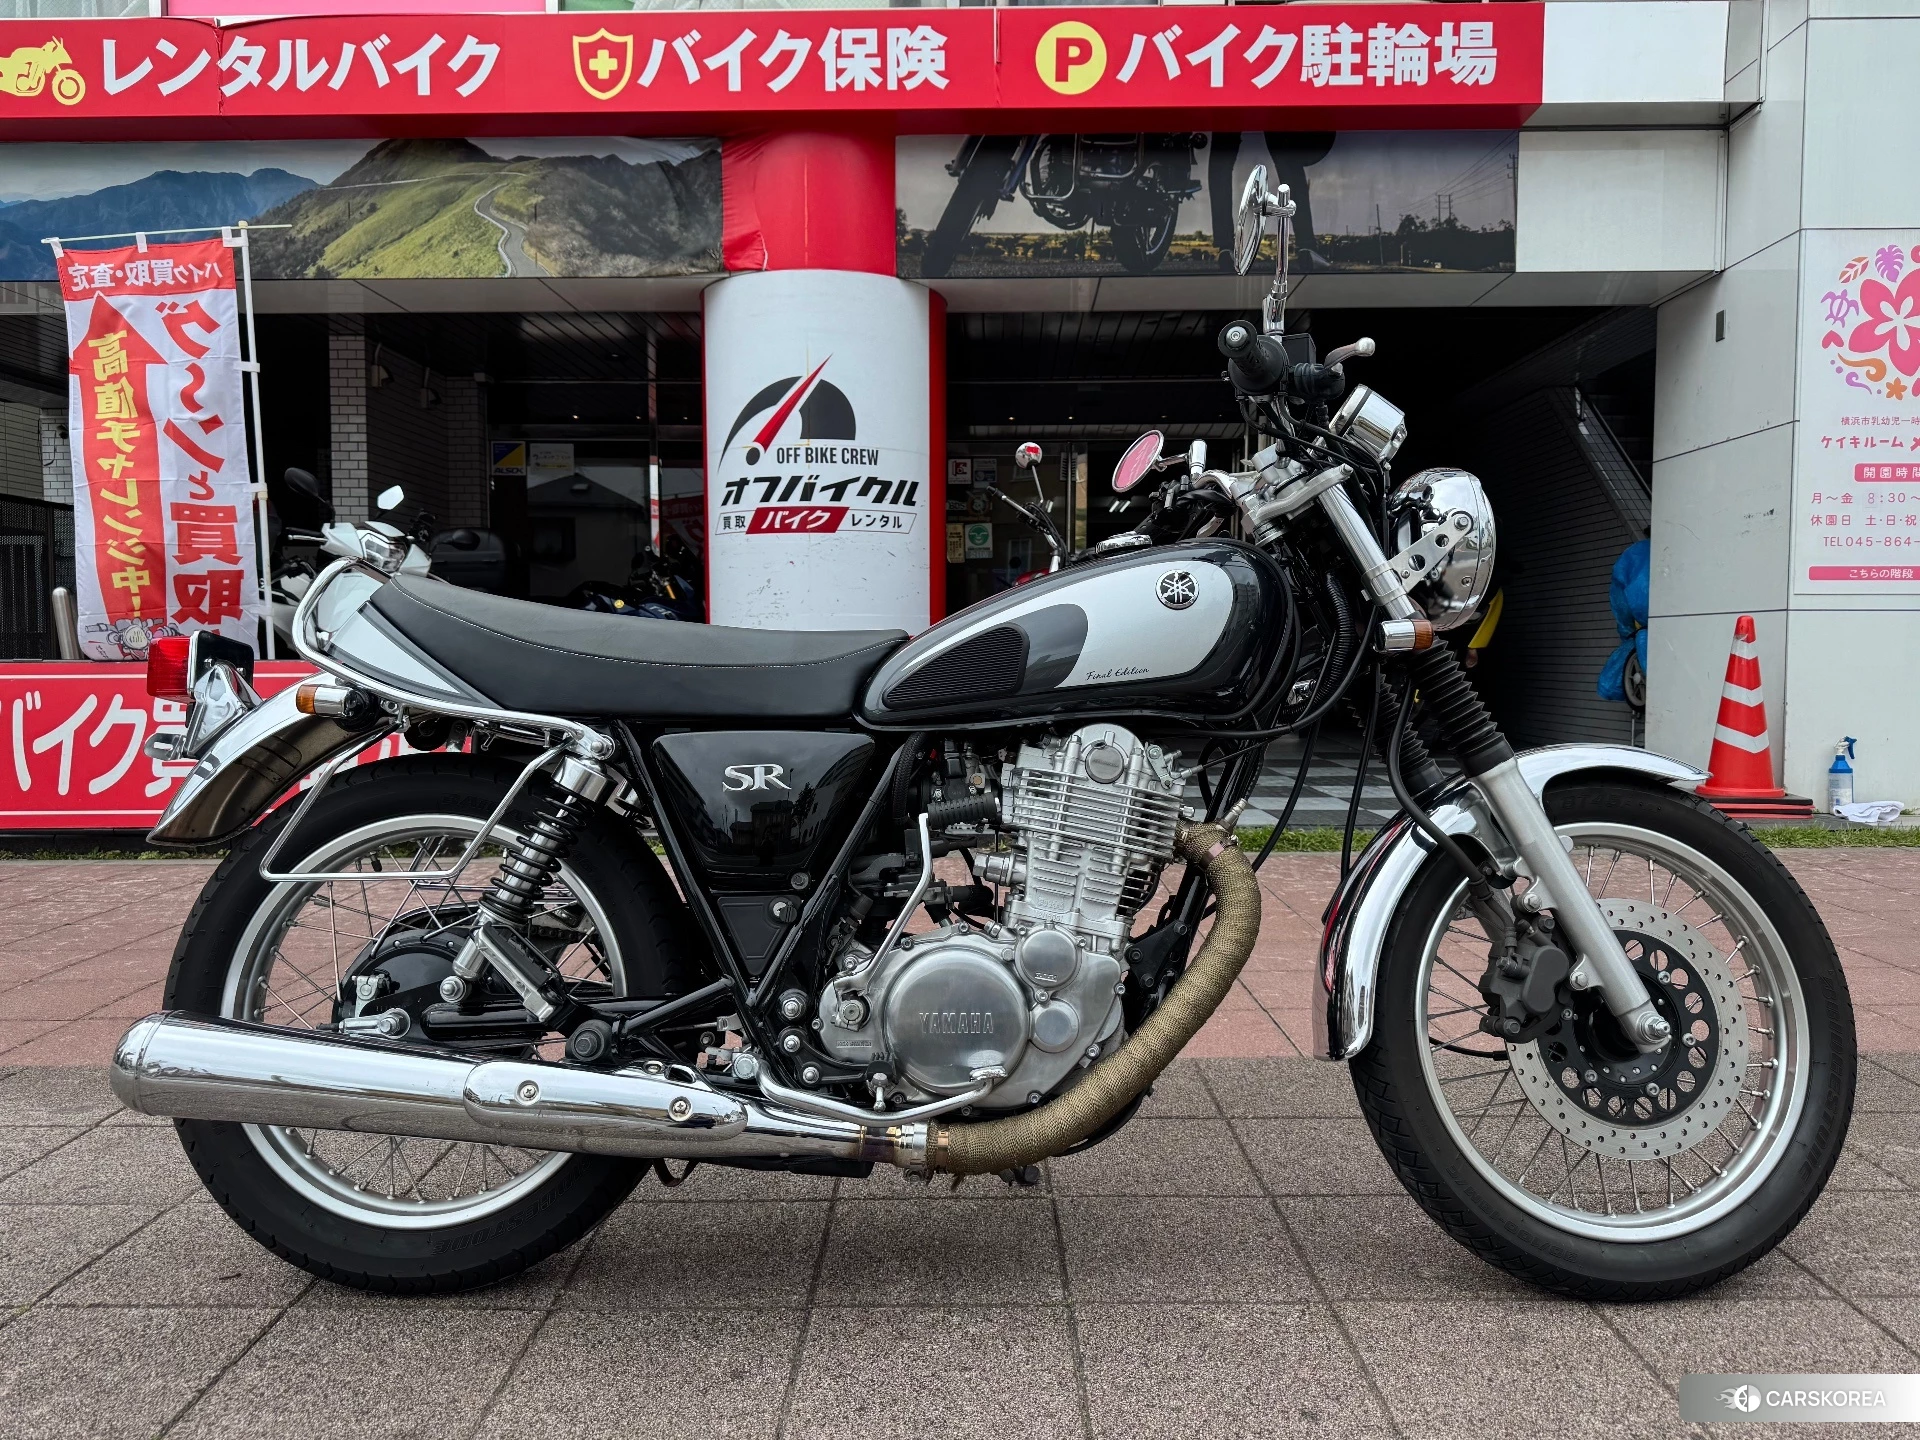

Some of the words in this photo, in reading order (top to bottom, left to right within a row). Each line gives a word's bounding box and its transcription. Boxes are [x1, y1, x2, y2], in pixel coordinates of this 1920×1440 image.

[102, 32, 501, 97] レンタルバイク
[638, 26, 950, 92] バイク保険
[1116, 21, 1498, 88] バイク駐輪場
[1821, 436, 1904, 449] ケイキルーム
[776, 447, 801, 464] OFF
[805, 446, 838, 464] BIKE
[841, 447, 879, 465] CREW
[721, 474, 919, 507] オフバイクル
[723, 514, 746, 530] 買取
[761, 509, 831, 530] バイク
[851, 513, 903, 529] レンタル
[1811, 515, 1851, 526] 休園日
[1849, 568, 1914, 579] こちらの階段
[1085, 670, 1113, 681] Final
[1115, 667, 1150, 678] Edition
[722, 763, 793, 792] SR
[919, 1012, 995, 1034] YAMAHA
